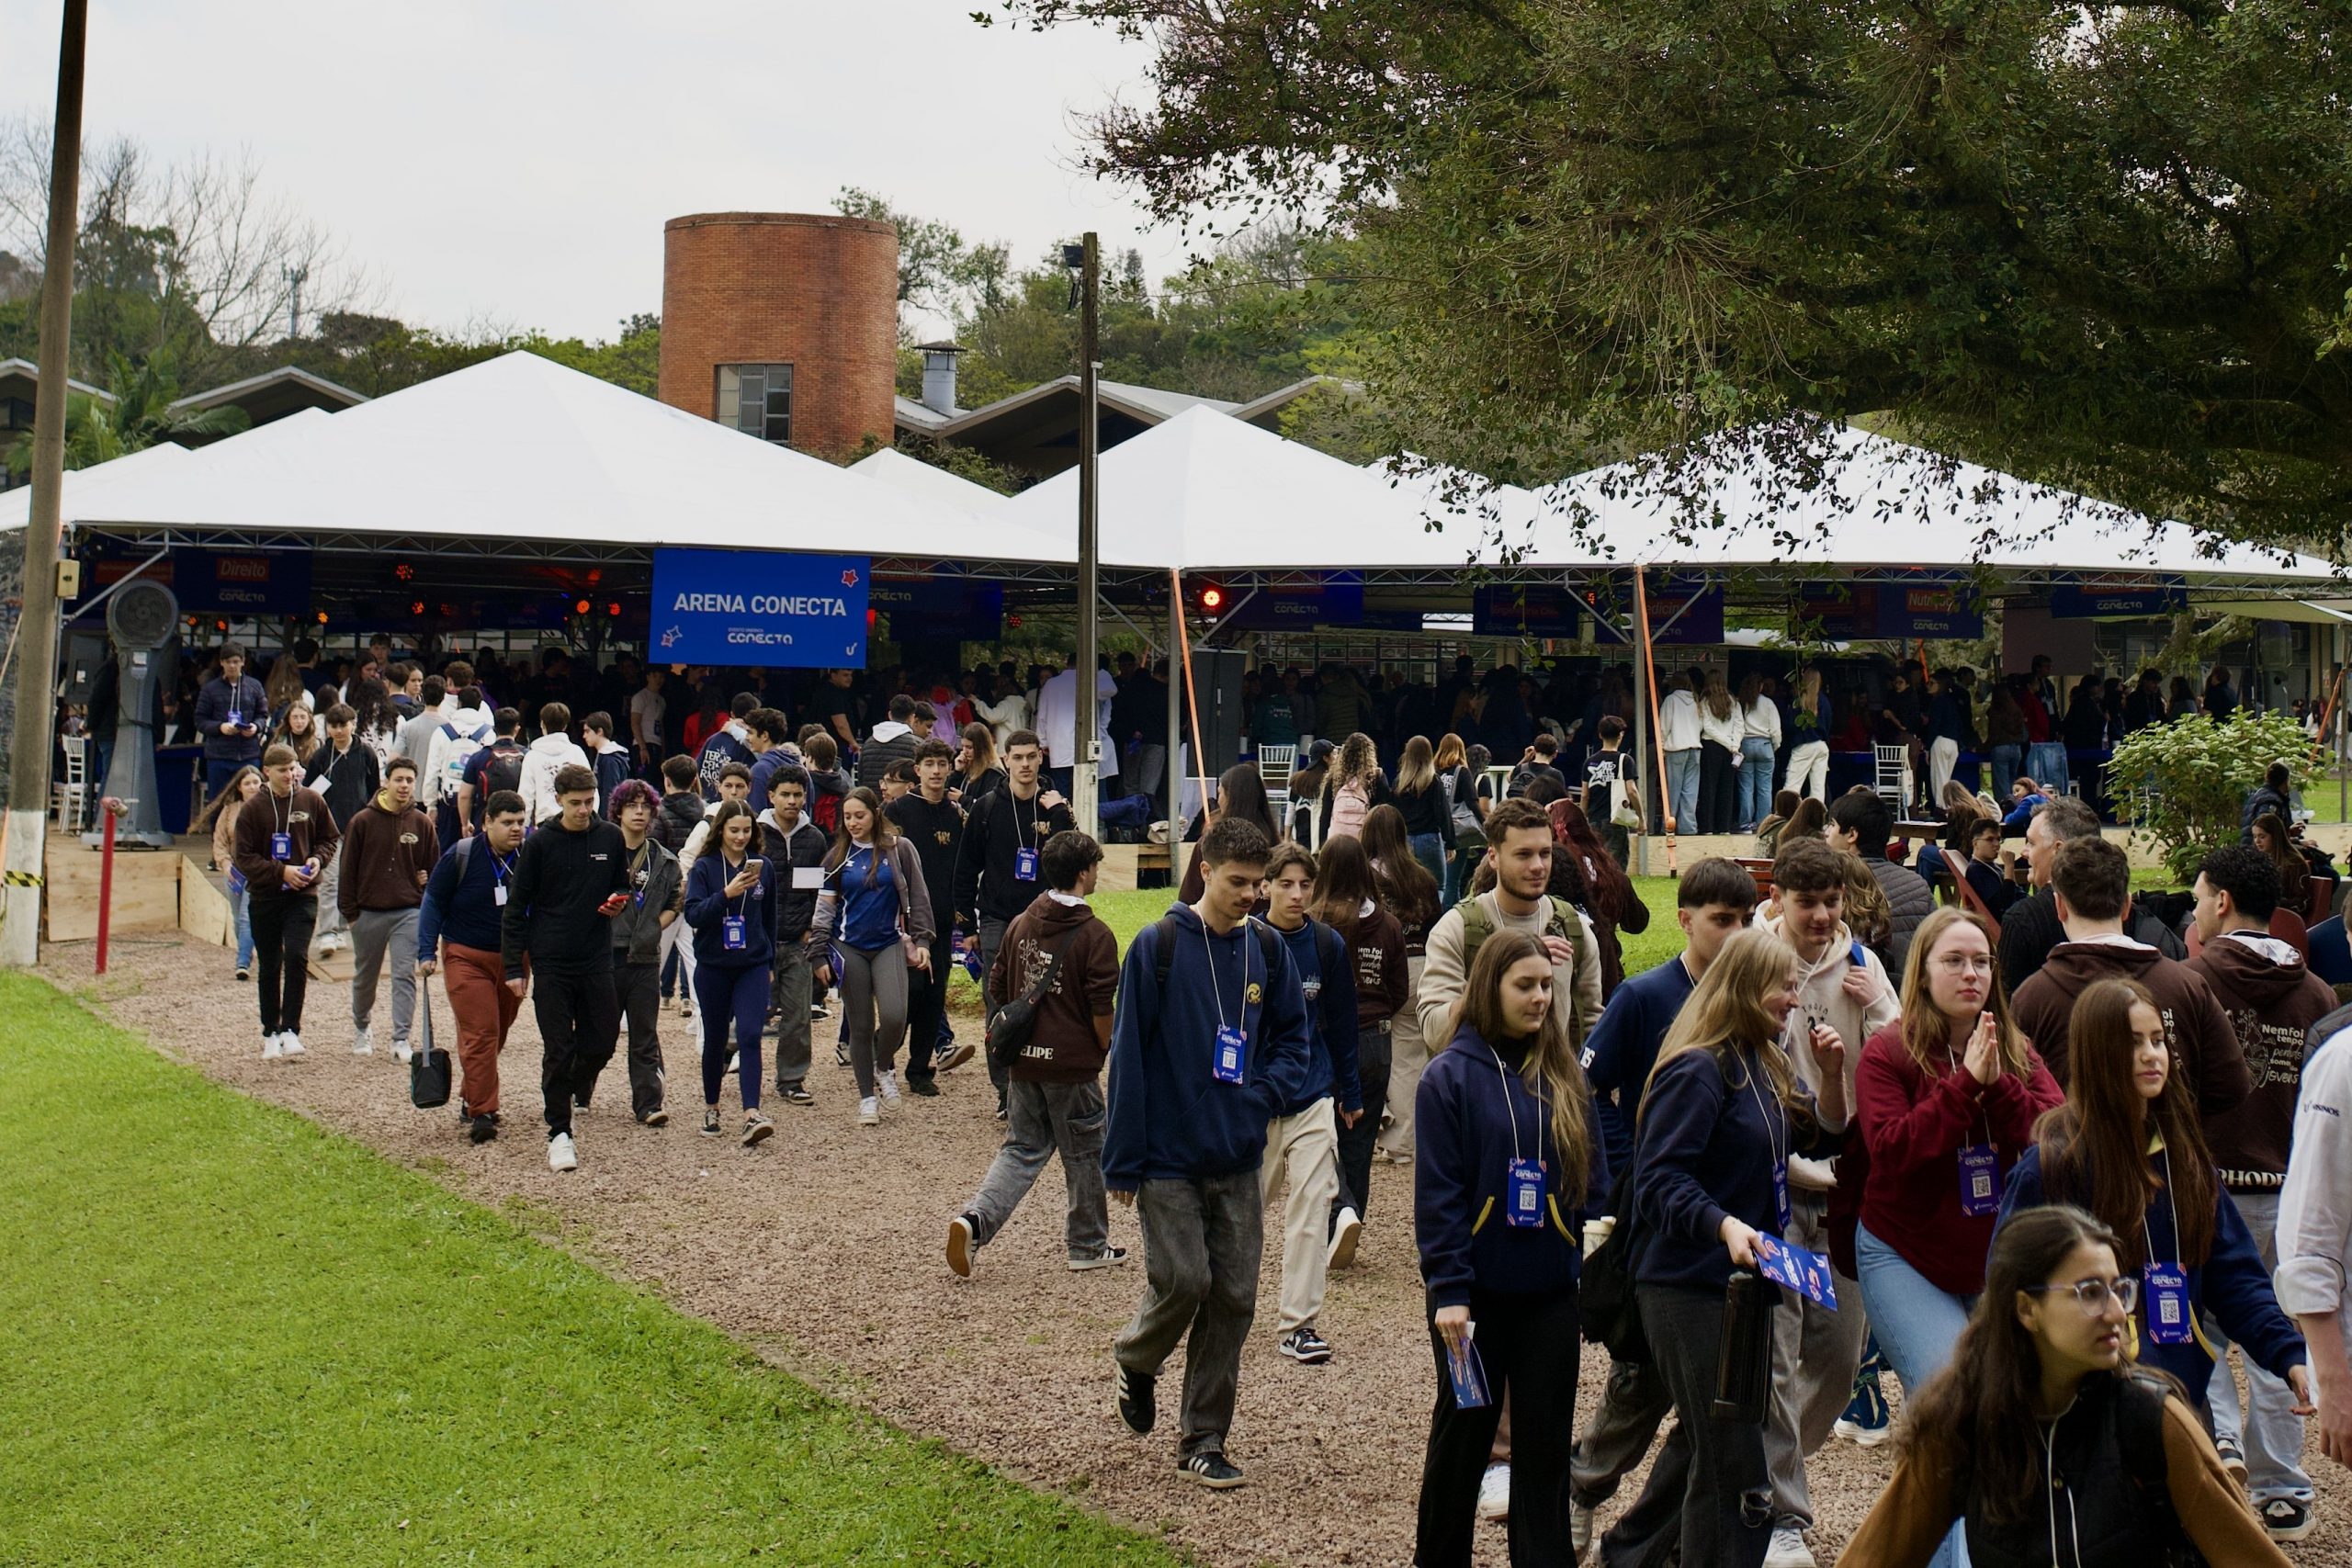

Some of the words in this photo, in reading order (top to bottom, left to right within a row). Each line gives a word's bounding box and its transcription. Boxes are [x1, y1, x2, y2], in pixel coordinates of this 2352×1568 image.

[221, 559, 267, 578] Direito
[673, 592, 746, 613] ARENA
[752, 595, 847, 616] CONECTA
[2262, 1024, 2289, 1036] Nem
